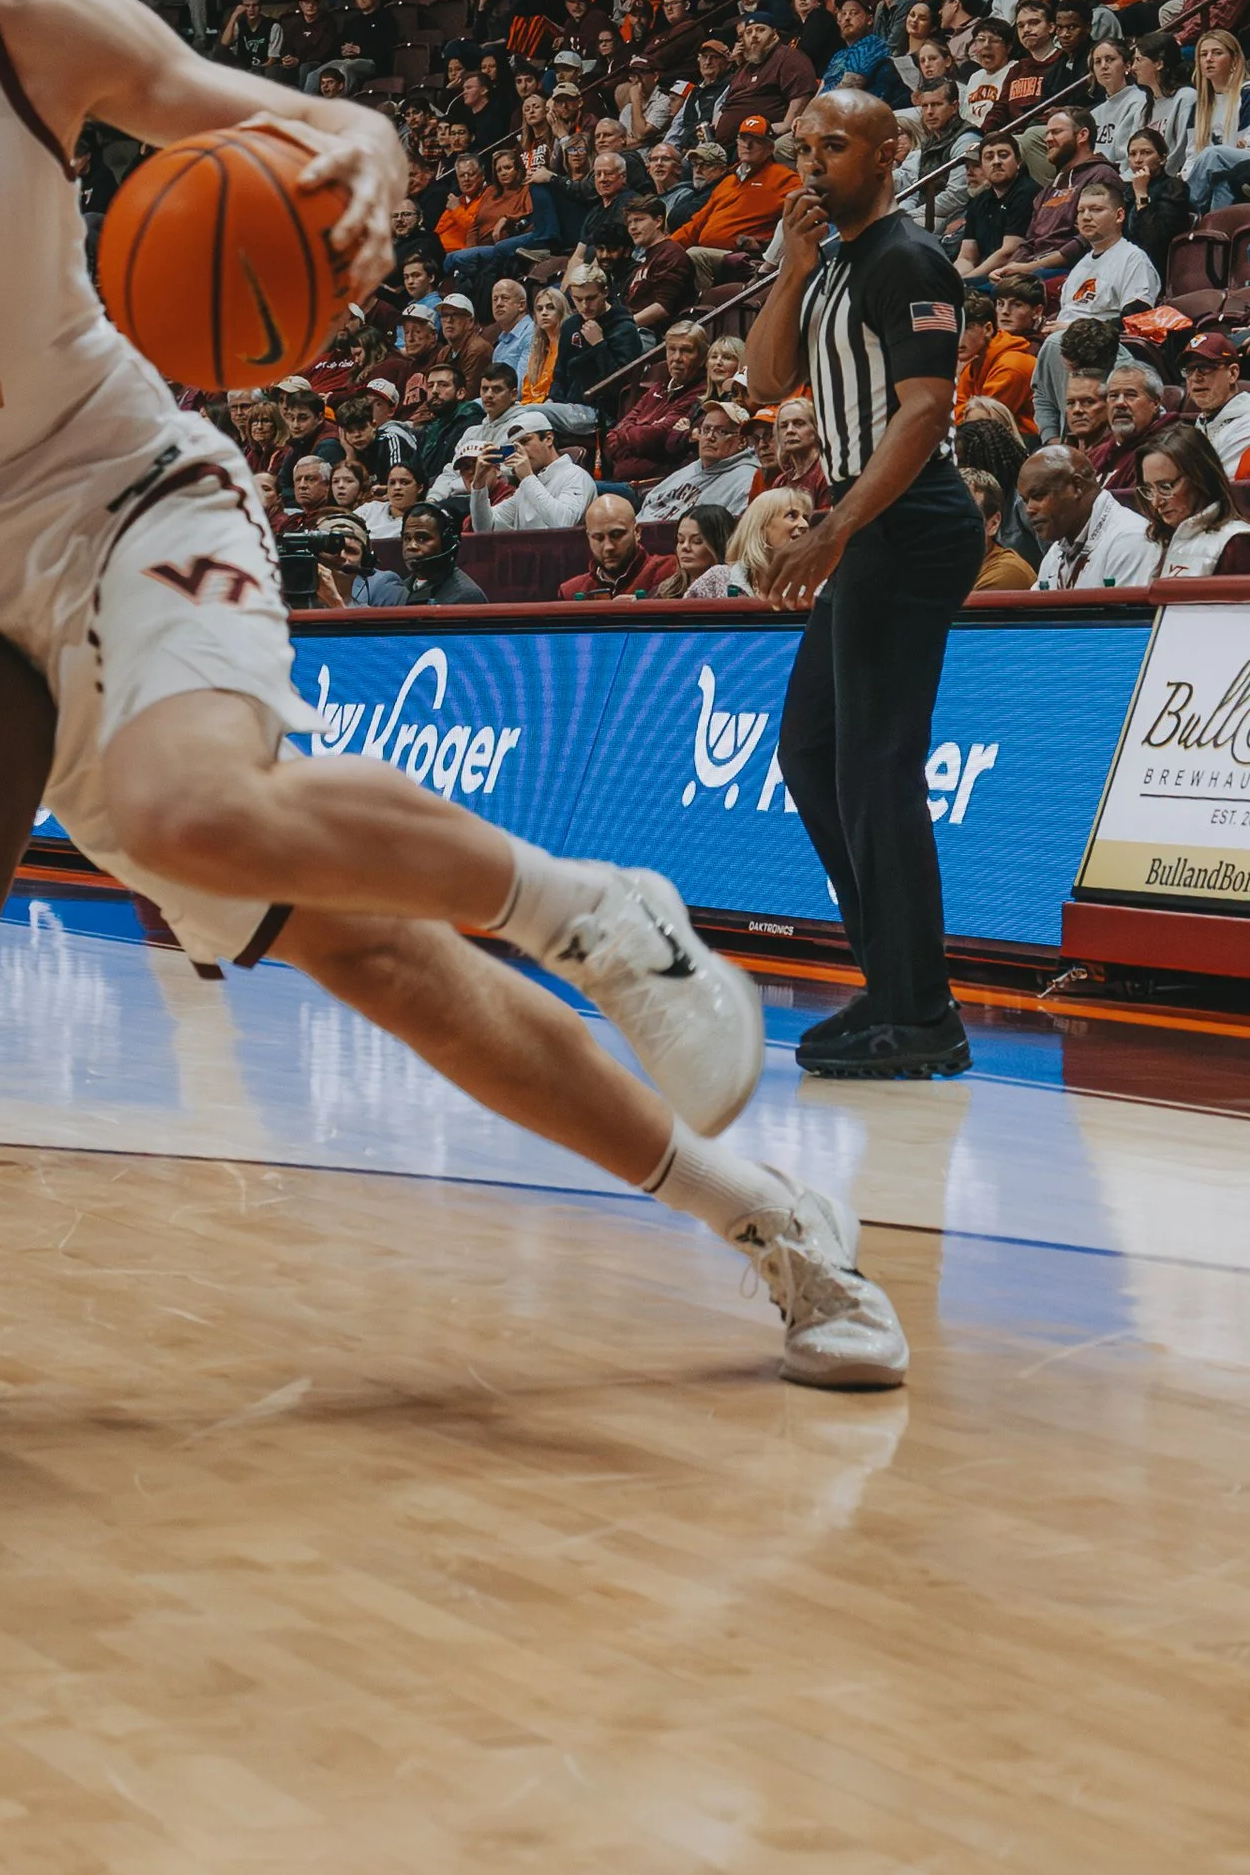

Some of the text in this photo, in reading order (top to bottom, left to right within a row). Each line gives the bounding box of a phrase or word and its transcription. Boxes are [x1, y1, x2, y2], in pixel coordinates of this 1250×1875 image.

[140, 554, 264, 607] VT
[361, 647, 521, 804] Kroger
[1210, 809, 1237, 826] EST.
